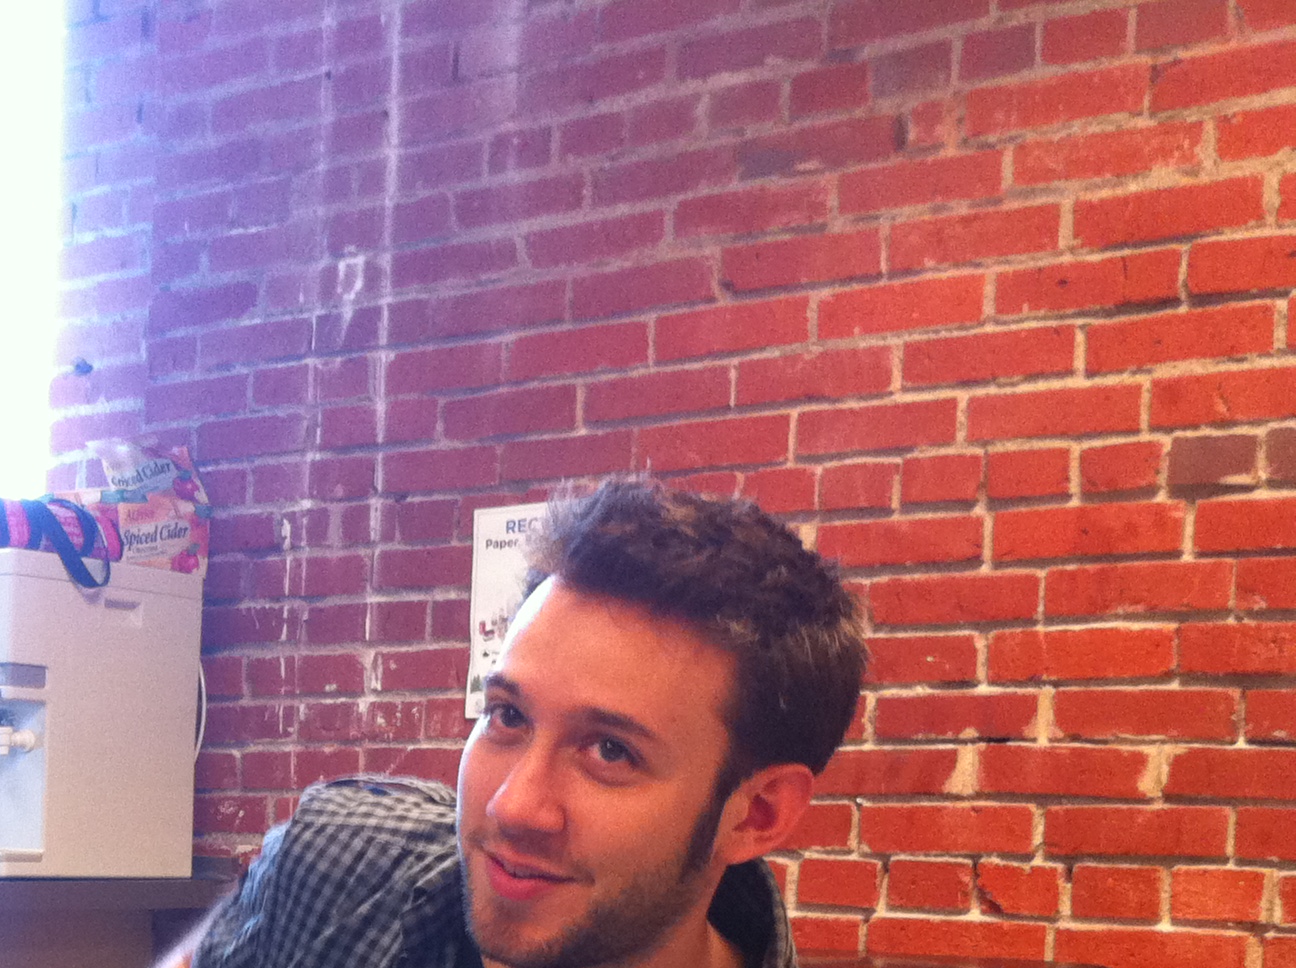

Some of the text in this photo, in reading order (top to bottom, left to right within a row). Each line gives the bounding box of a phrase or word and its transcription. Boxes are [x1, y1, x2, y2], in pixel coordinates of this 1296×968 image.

[141, 461, 171, 480] Cider
[124, 524, 158, 551] Spiced
[159, 521, 189, 541] Cider
